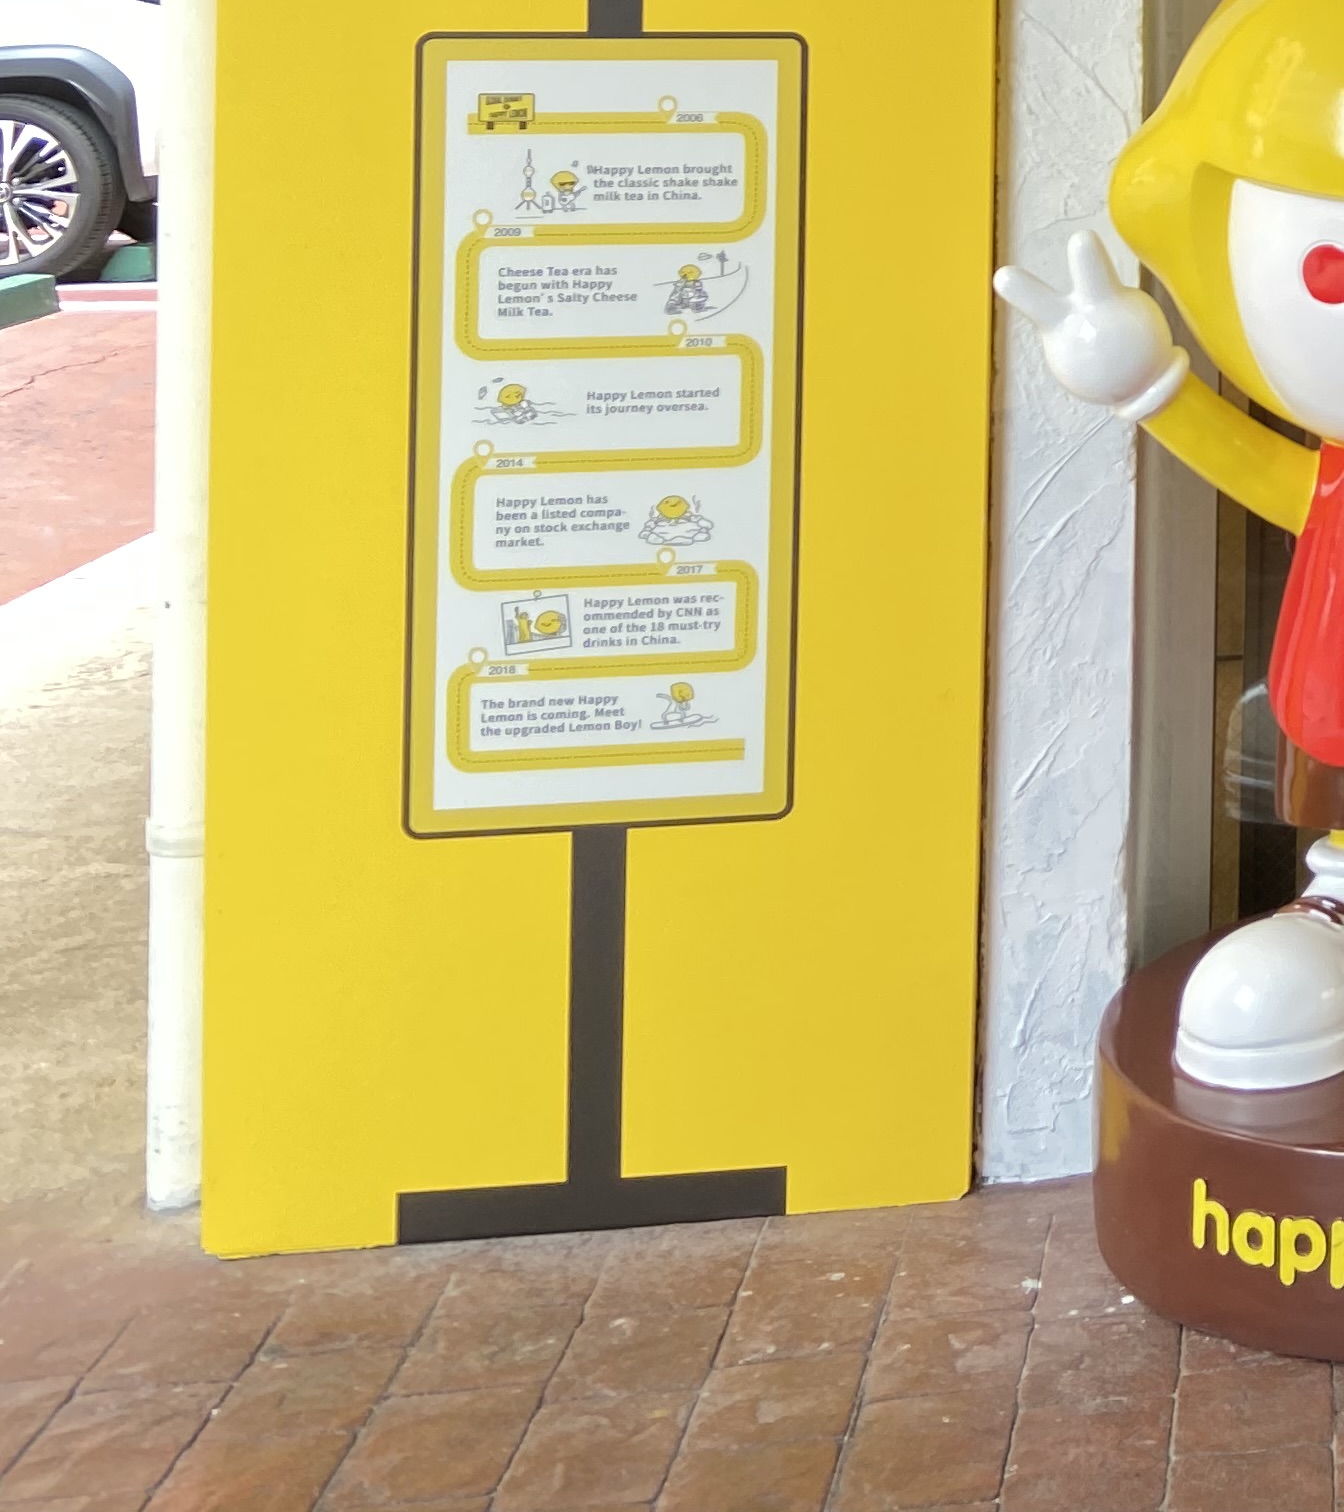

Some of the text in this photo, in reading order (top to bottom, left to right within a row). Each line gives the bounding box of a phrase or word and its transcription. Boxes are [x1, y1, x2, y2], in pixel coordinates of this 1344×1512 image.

[595, 164, 732, 178] Happy Lemon brought
[593, 176, 738, 188] the classic shake shake
[593, 190, 620, 201] milk
[624, 192, 643, 201] tea
[647, 190, 659, 200] in
[498, 265, 617, 277] Cheese Tea era has
[498, 279, 612, 292] begun with Happy
[557, 292, 589, 305] Salty
[592, 291, 637, 302] Cheese
[497, 306, 552, 317] Milk Tea.
[586, 386, 719, 402] Happy Lemon started
[586, 404, 602, 414] its
[605, 403, 653, 416] journey
[496, 494, 608, 509] Happy Lemon has
[496, 510, 527, 521] been
[530, 511, 537, 520] a
[541, 507, 576, 519] listed
[495, 520, 629, 536] ny on stock exchange
[583, 598, 624, 609] Happy
[627, 596, 669, 606] Lemon
[672, 595, 697, 604] was
[583, 606, 719, 622] ommended by CNN as
[583, 626, 606, 635] one
[609, 622, 622, 633] of
[626, 622, 646, 633] the
[582, 636, 622, 648] drinks
[625, 636, 637, 646] in
[481, 695, 618, 709] The brand new Happy
[481, 713, 523, 723] Lemon
[527, 711, 537, 721] is
[594, 707, 624, 717] Meet
[480, 726, 501, 737] the
[504, 721, 564, 737] upgraded
[568, 722, 610, 732] Lemon
